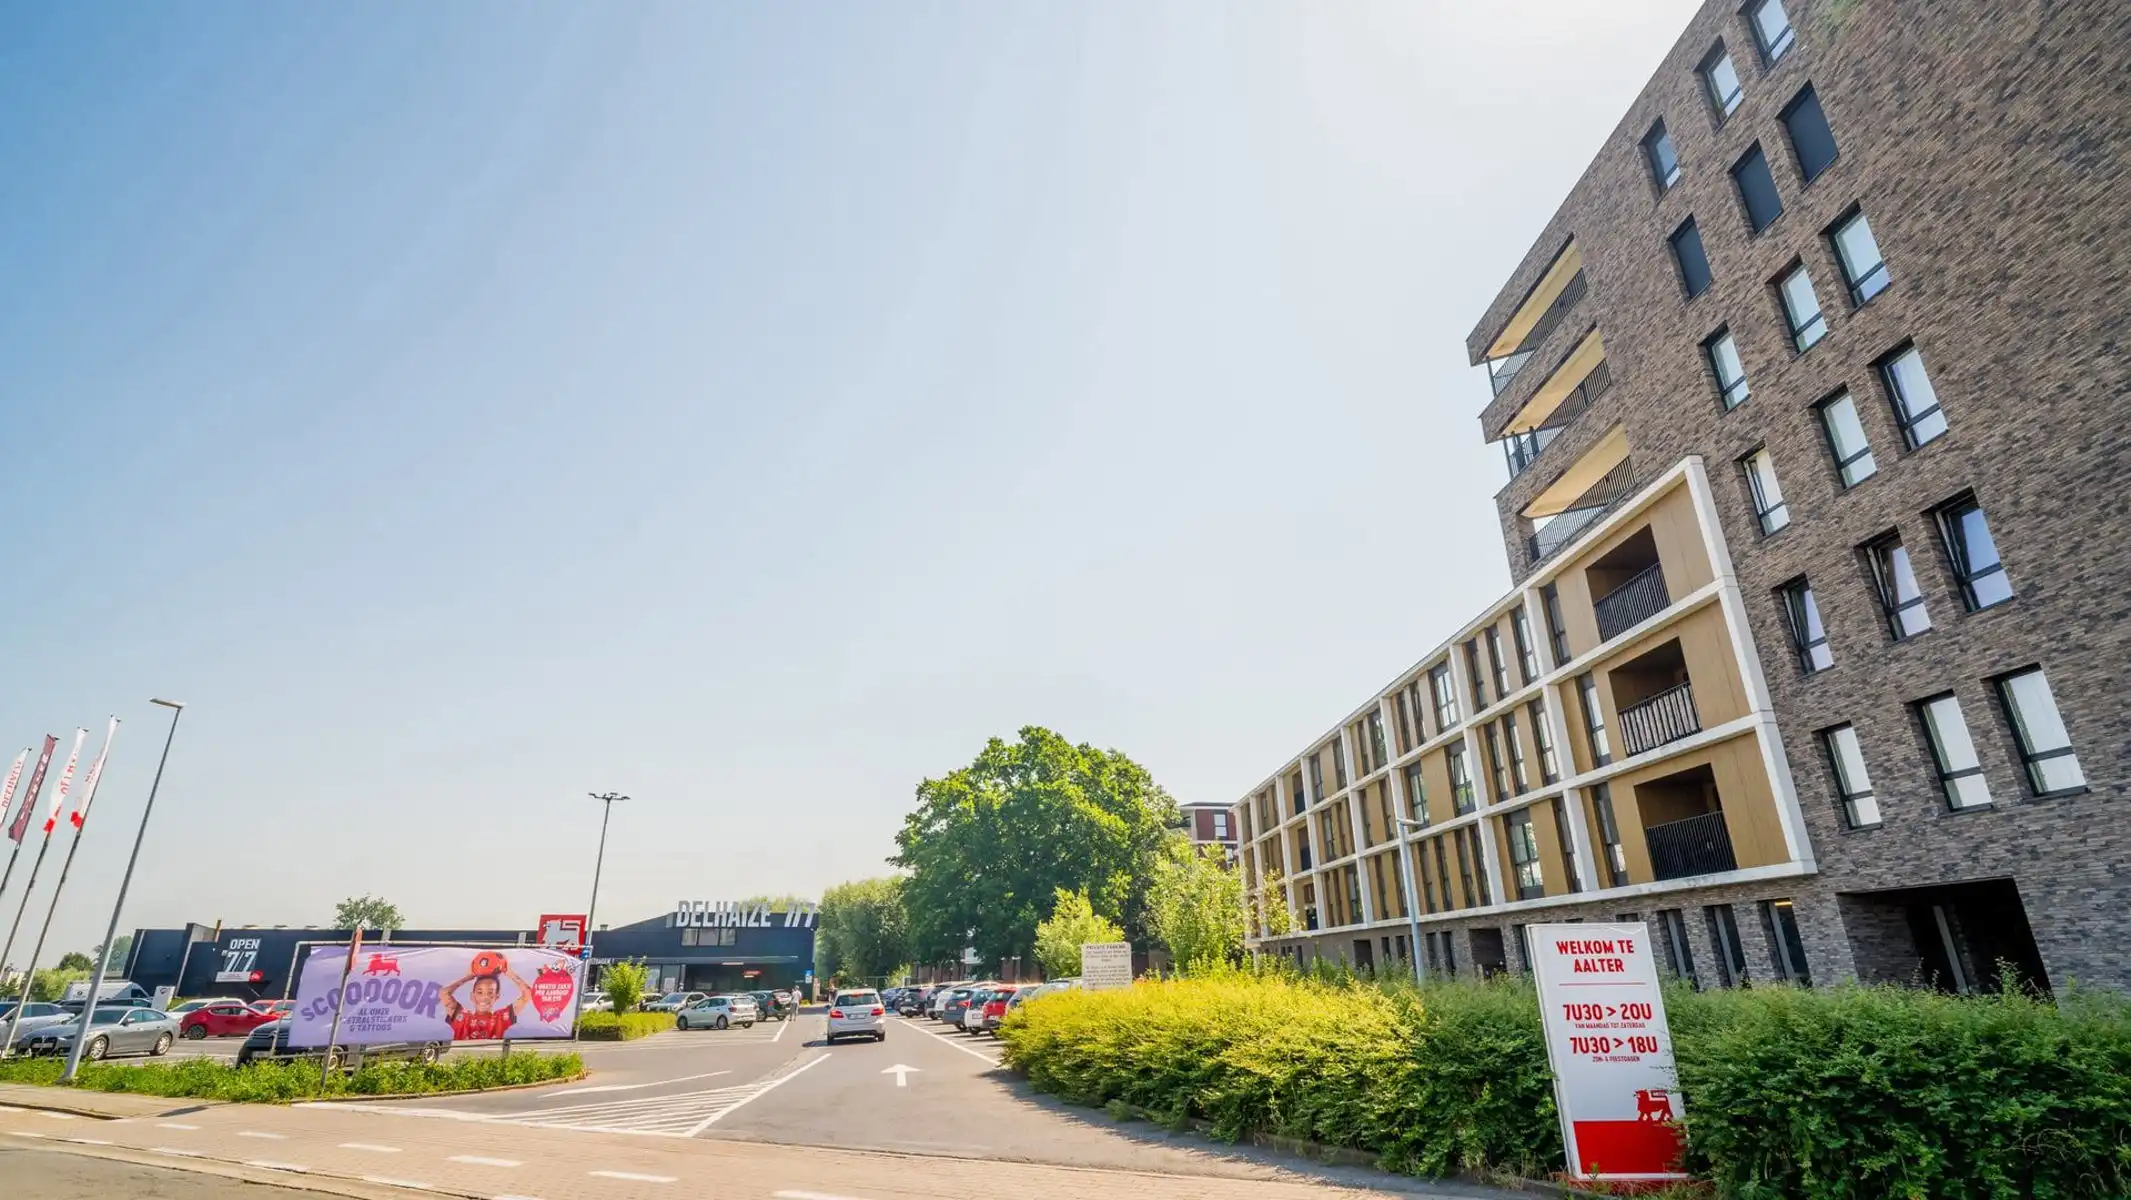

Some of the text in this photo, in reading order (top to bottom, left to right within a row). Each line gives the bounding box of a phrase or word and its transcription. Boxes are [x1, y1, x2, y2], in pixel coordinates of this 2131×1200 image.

[676, 900, 816, 928] DELHAIZE 7/7
[230, 938, 261, 950] OPEN
[1556, 940, 1635, 955] WELKOM TE
[225, 951, 257, 972] 7/7
[1574, 958, 1625, 973] AALTER
[1562, 1004, 1604, 1021] 7U30
[1621, 1003, 1653, 1021] 20U
[1569, 1036, 1611, 1054] 7U30
[1627, 1036, 1658, 1053] 18U
